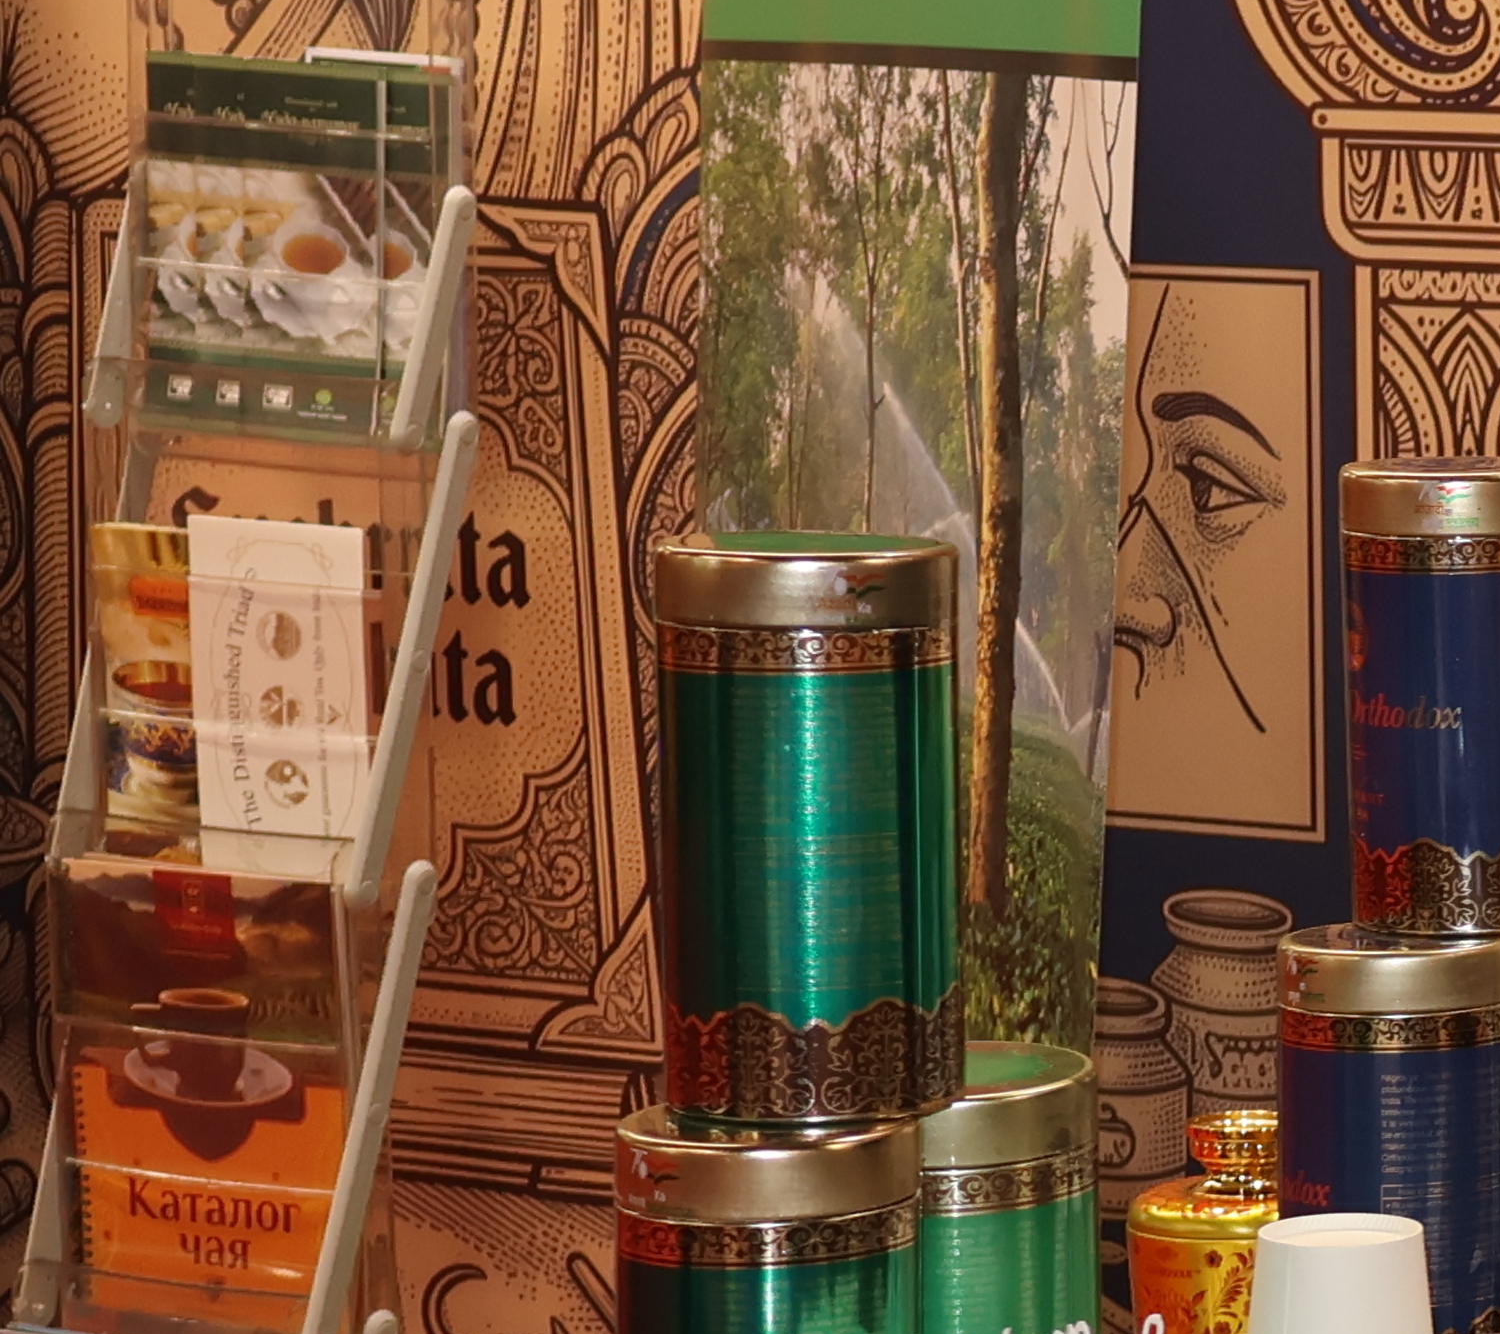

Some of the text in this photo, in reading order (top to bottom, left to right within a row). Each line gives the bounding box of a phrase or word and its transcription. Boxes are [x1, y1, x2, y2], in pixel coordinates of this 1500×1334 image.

[225, 586, 263, 830] The Distiguished Triad
[126, 1176, 300, 1234] Каталог
[179, 1233, 251, 1270] чая
